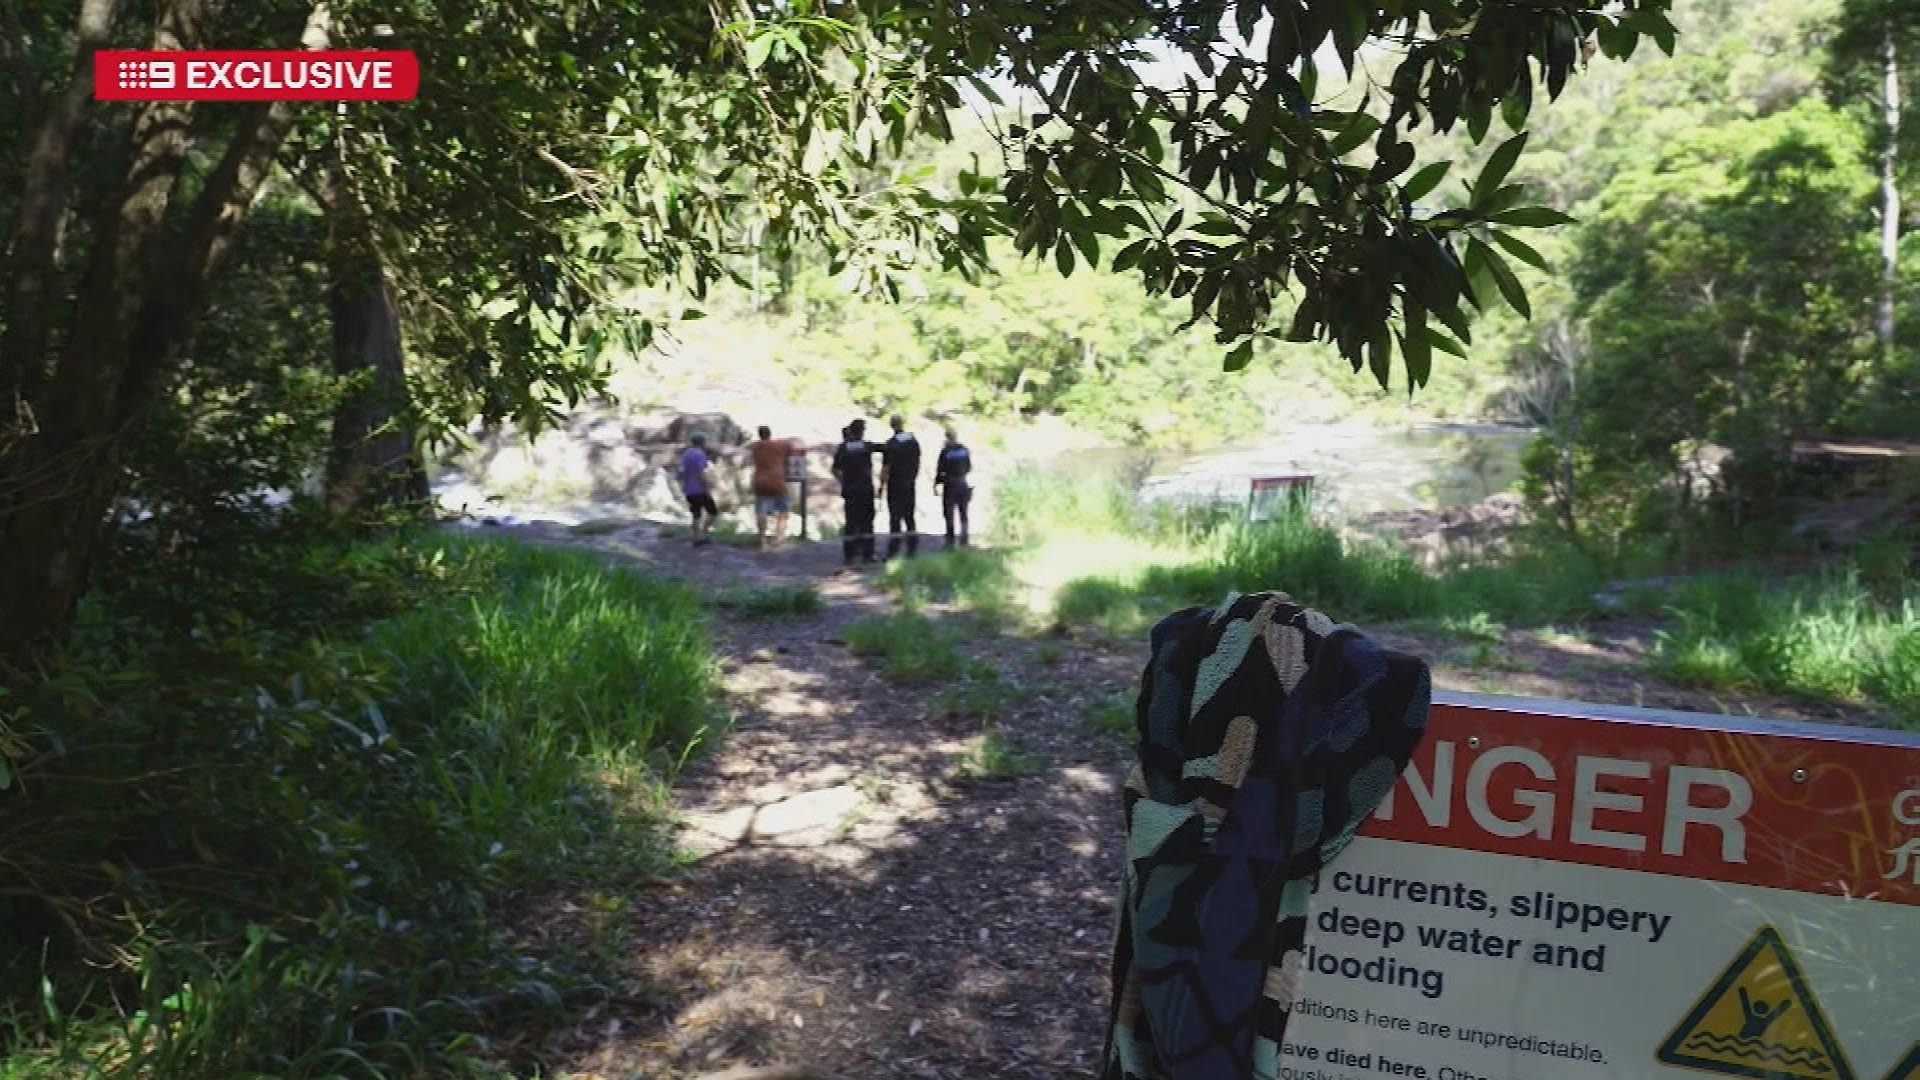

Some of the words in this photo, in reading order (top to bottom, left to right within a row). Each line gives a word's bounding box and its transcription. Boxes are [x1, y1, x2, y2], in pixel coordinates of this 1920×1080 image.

[1316, 906, 1404, 948] deep
[1417, 924, 1522, 960] water
[1532, 944, 1607, 973] and
[1332, 870, 1498, 918] currents,
[1509, 890, 1672, 943] slippery
[1290, 998, 1359, 1023] ditions
[1365, 1008, 1411, 1031] here
[1416, 1019, 1451, 1039] are
[1457, 1026, 1608, 1065] unpredictable.
[1325, 1047, 1371, 1069] died
